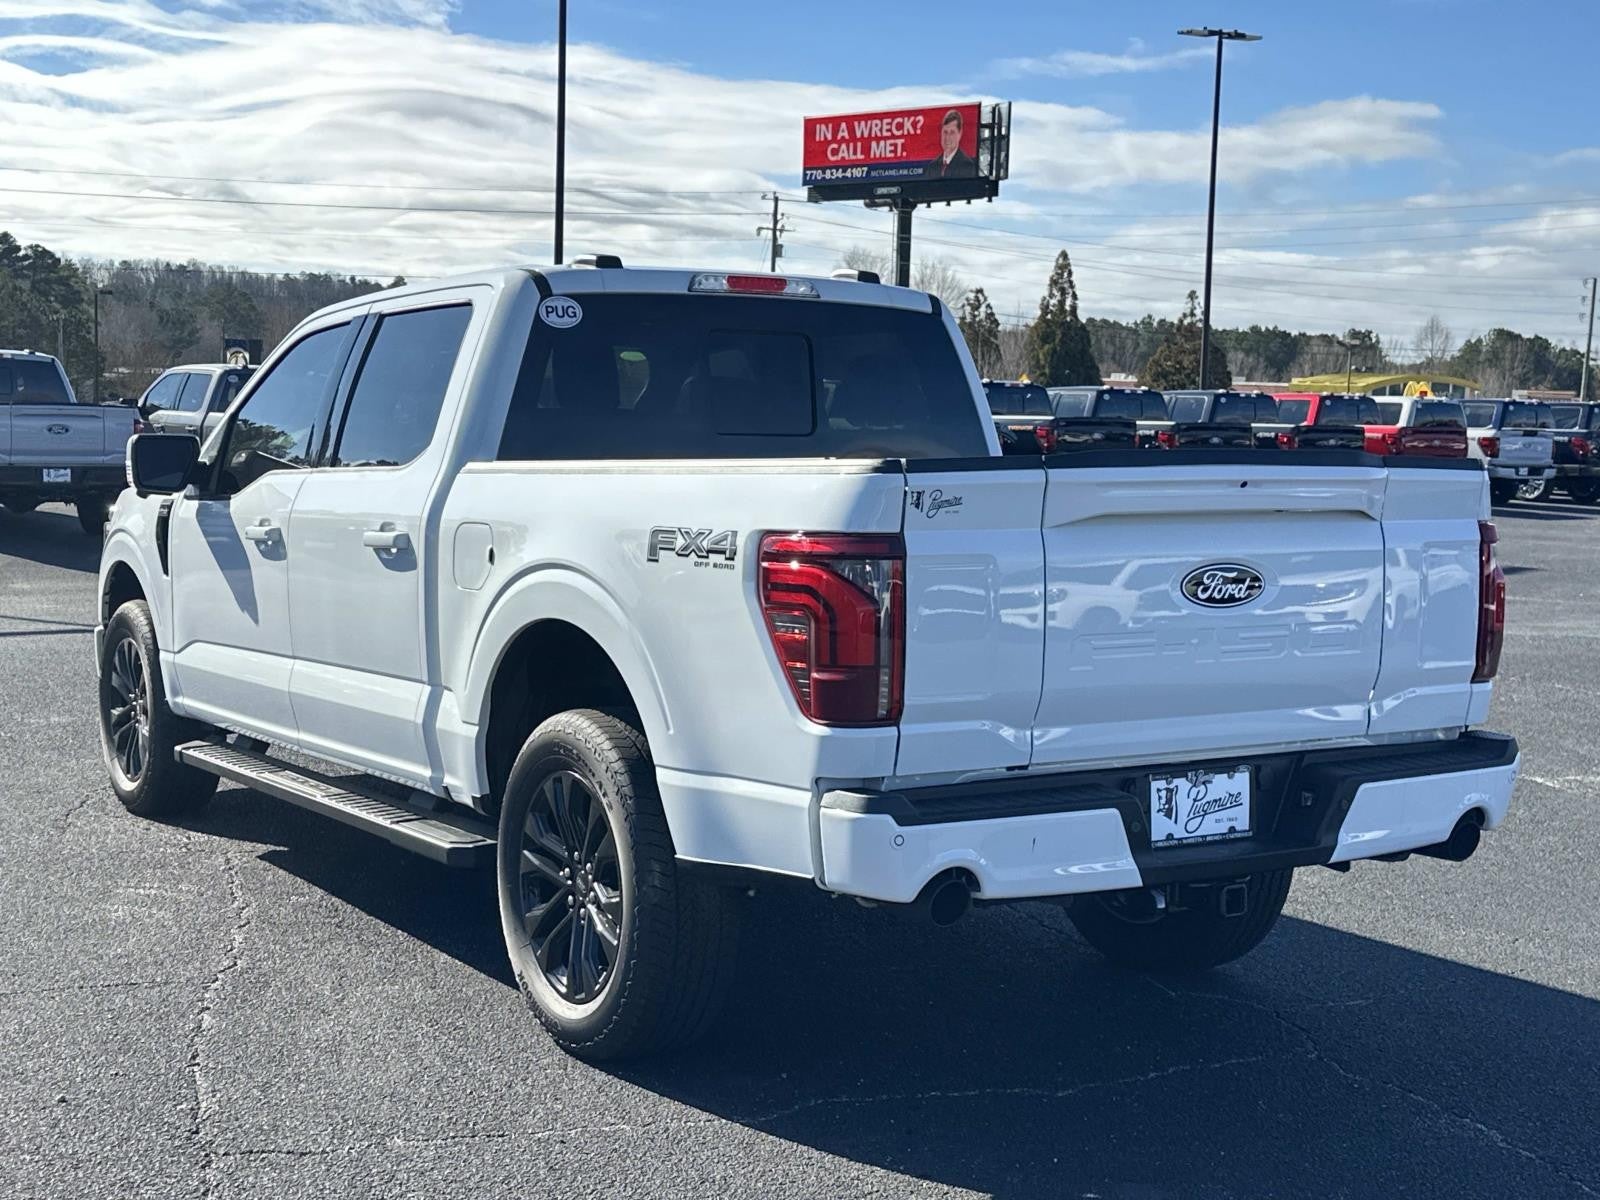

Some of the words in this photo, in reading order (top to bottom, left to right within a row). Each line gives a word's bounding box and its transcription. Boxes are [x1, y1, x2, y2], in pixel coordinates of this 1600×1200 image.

[815, 122, 833, 142] IN
[837, 122, 850, 140] A
[854, 115, 924, 138] WRECK?
[826, 143, 865, 161] CALL
[870, 139, 908, 159] MET.
[805, 167, 868, 181] 770-834-4107
[545, 305, 577, 318] PUG
[646, 526, 738, 563] FX4
[693, 560, 710, 568] OFF
[712, 562, 735, 571] ROAD
[1197, 570, 1251, 600] Ford
[1184, 782, 1243, 834] Pugmire
